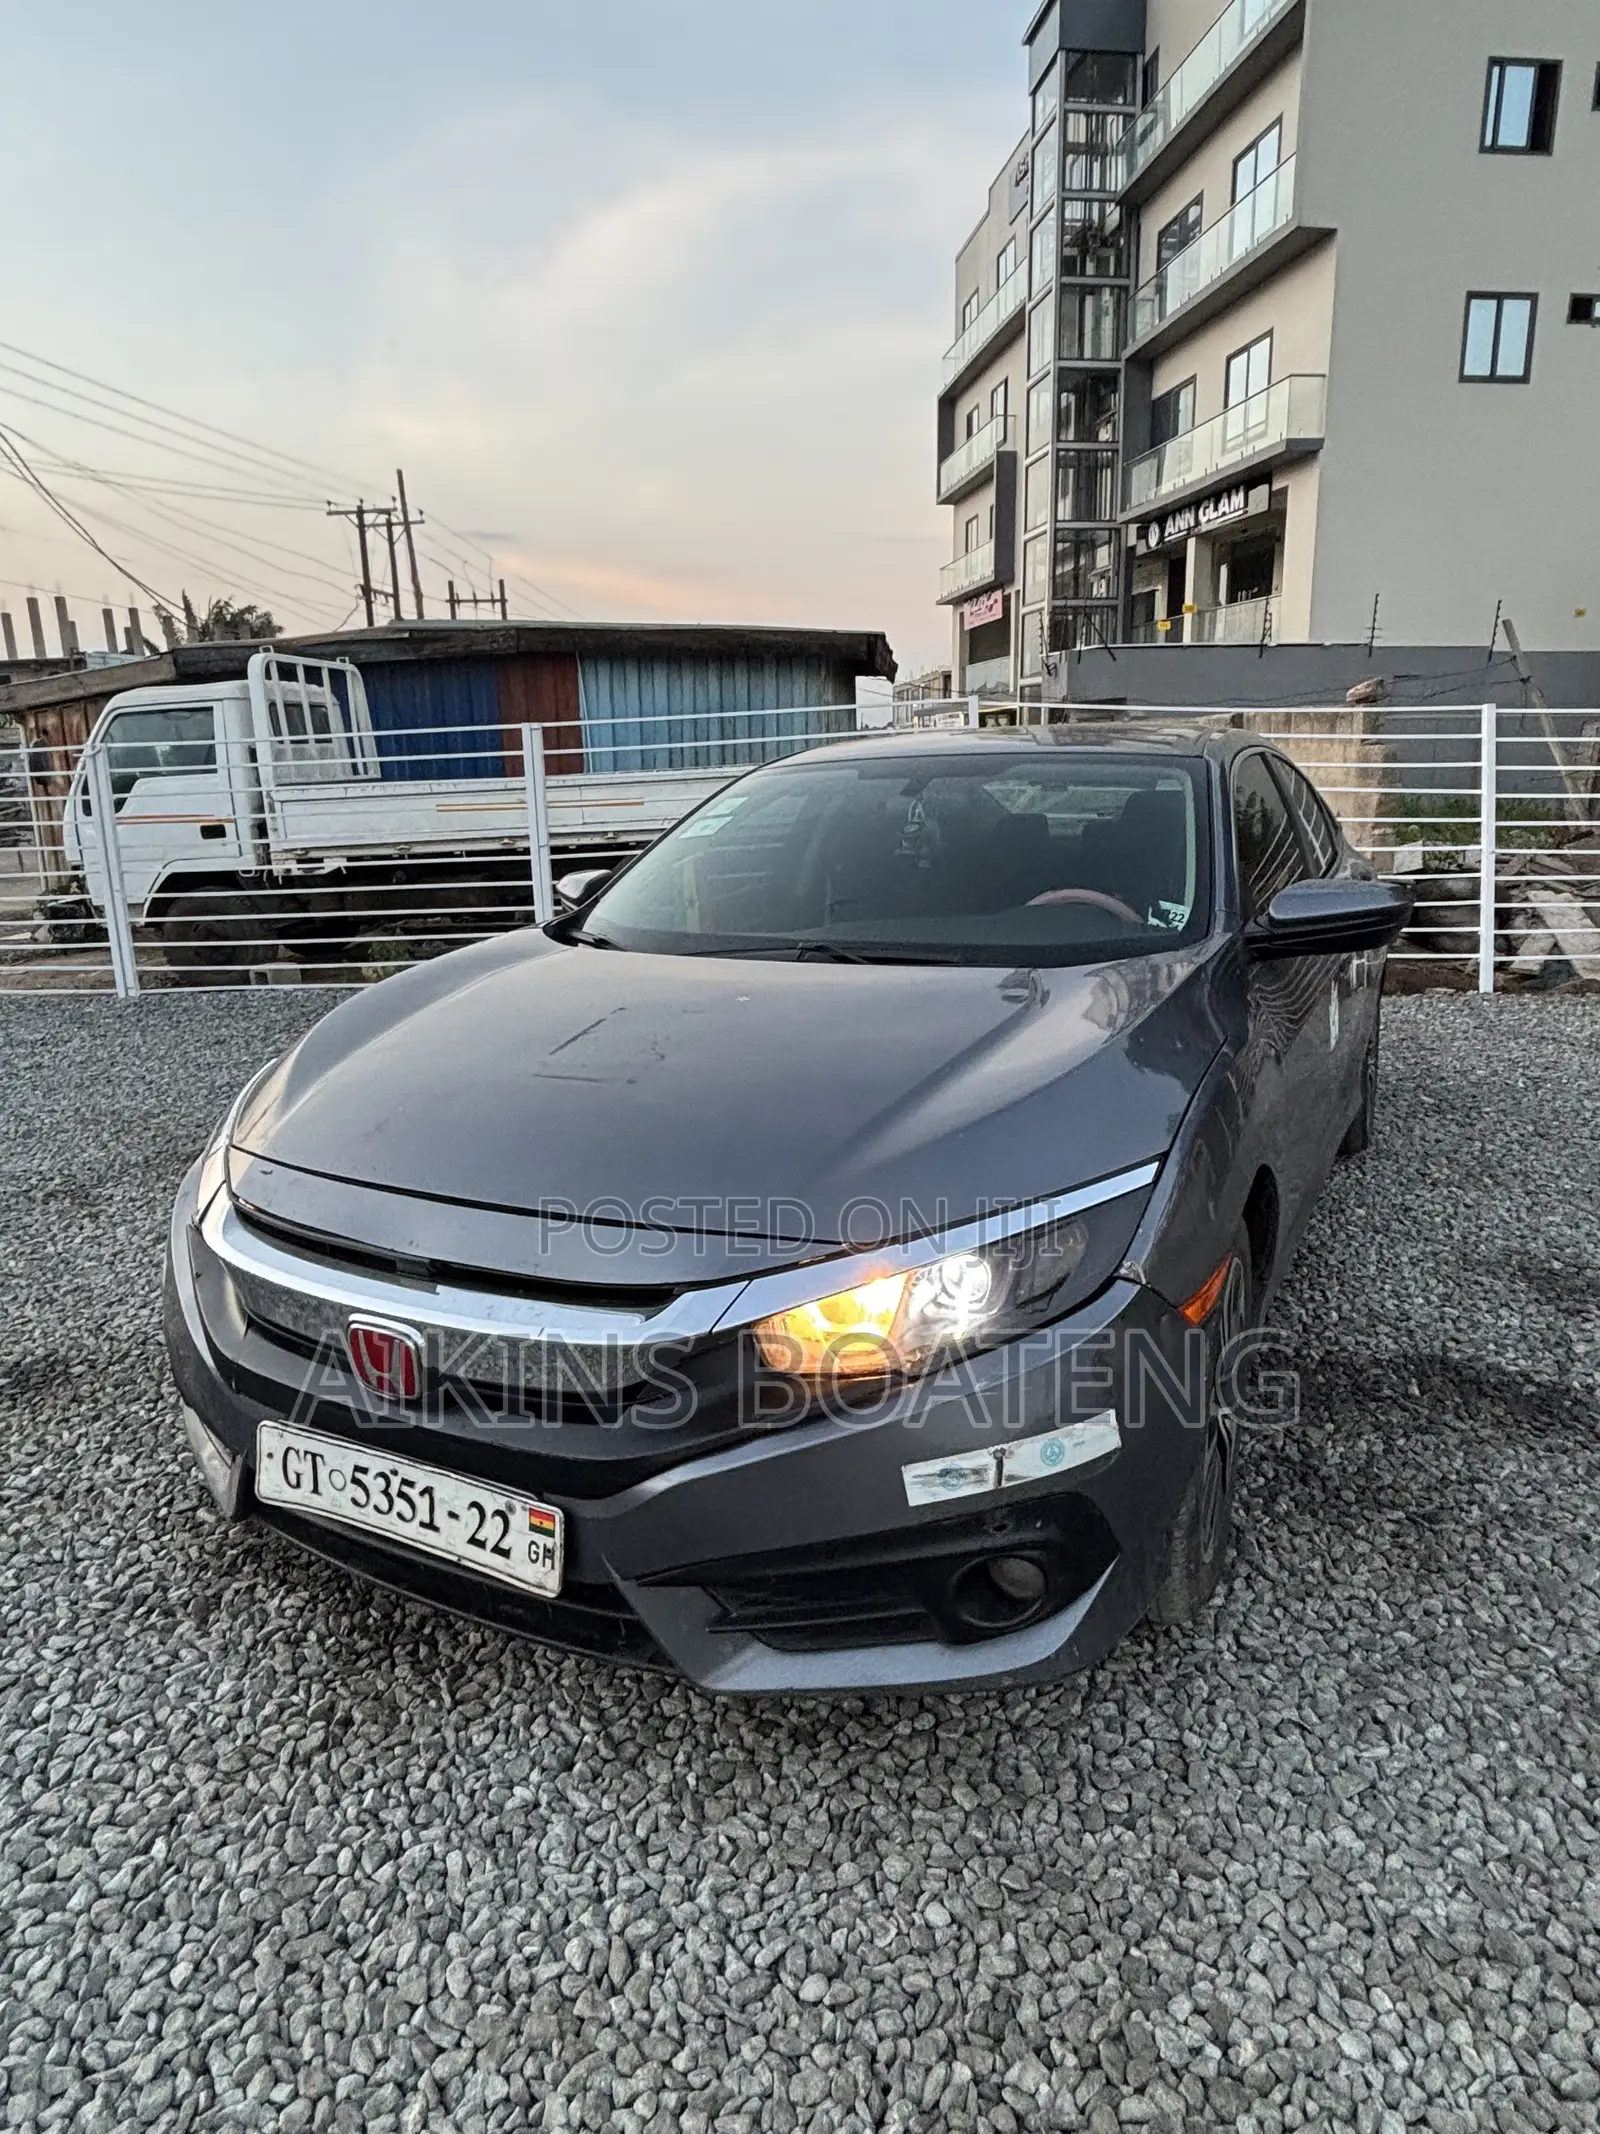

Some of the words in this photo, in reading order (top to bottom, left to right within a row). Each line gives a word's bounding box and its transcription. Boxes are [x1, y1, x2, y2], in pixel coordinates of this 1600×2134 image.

[1163, 504, 1196, 537] ANN
[1198, 485, 1245, 523] GLAM
[1171, 911, 1185, 923] 22
[281, 1445, 325, 1496] GT
[350, 1463, 514, 1560] 5351-22
[527, 1539, 556, 1571] GH
